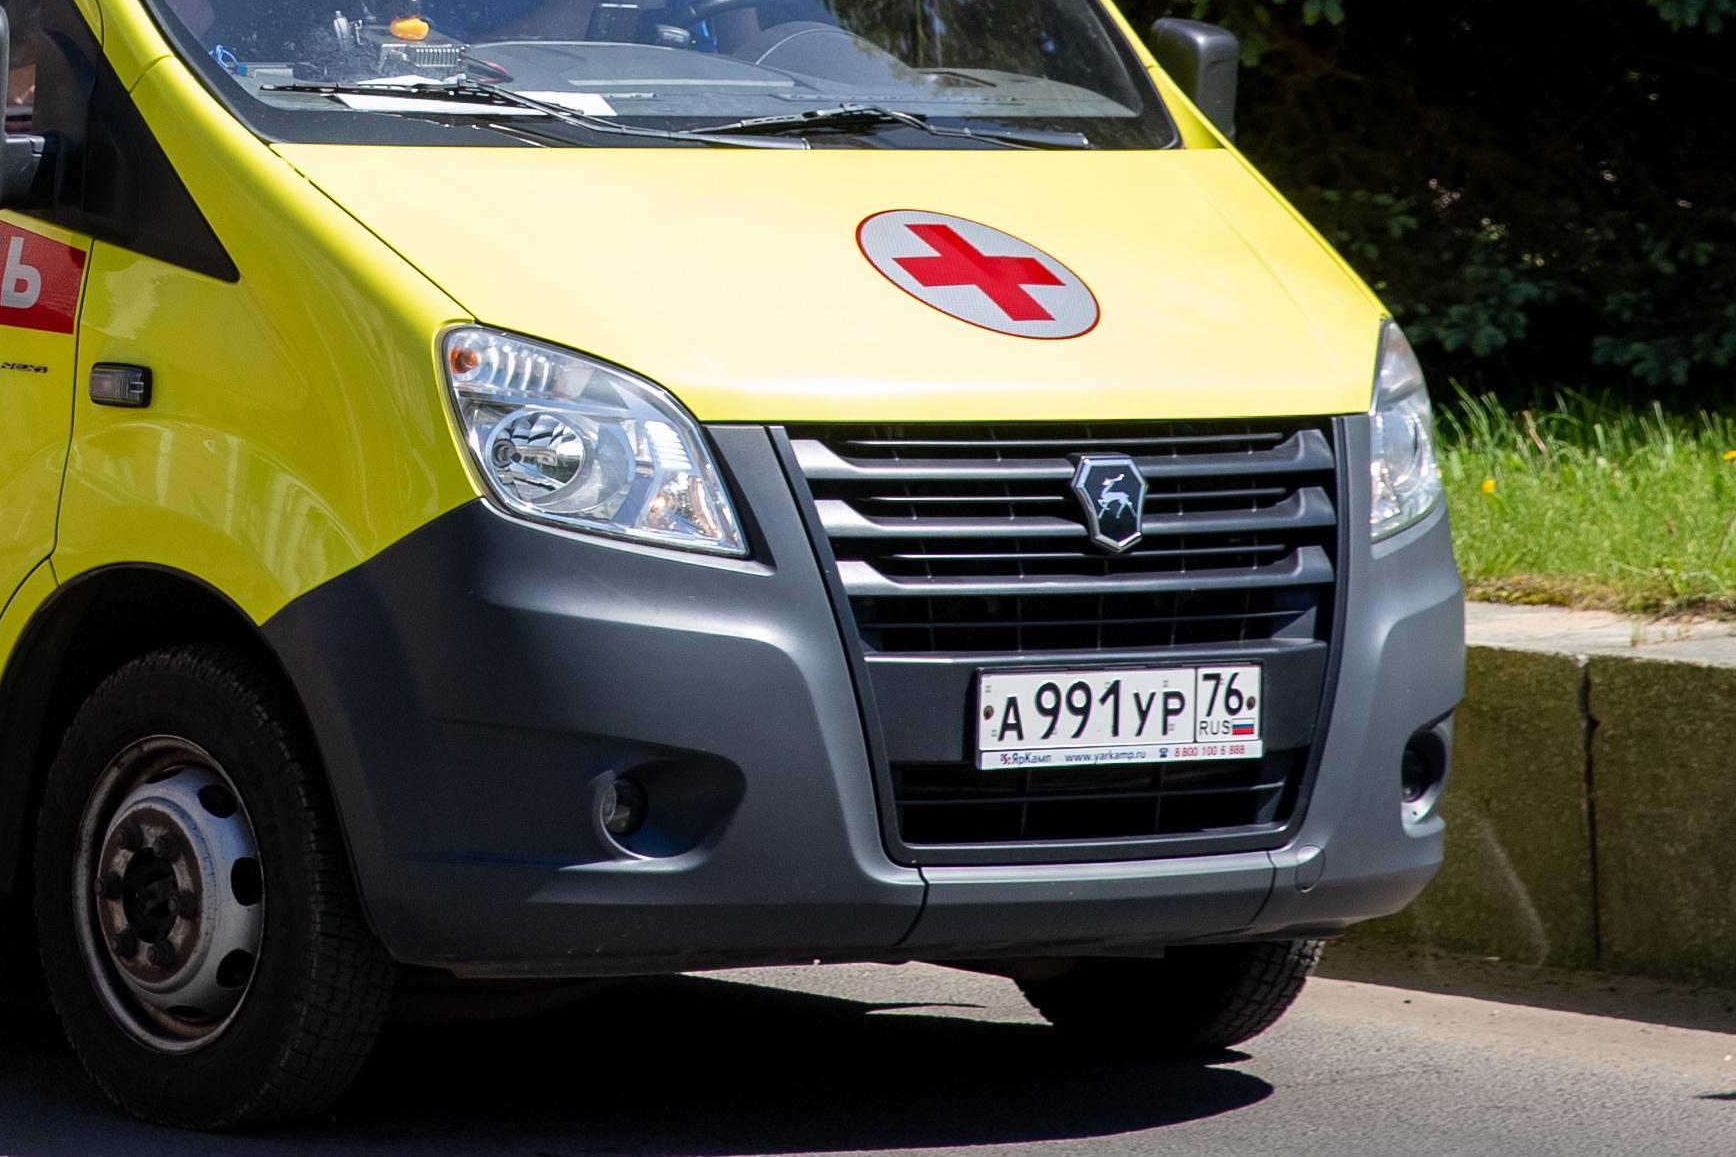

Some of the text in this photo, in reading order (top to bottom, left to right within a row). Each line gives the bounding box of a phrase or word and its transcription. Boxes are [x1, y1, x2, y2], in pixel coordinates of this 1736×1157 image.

[1202, 672, 1244, 717] 76
[1199, 719, 1231, 736] RUS
[1012, 752, 1052, 766] ЯрКамп
[1064, 750, 1147, 765] www.yarkamp.ru
